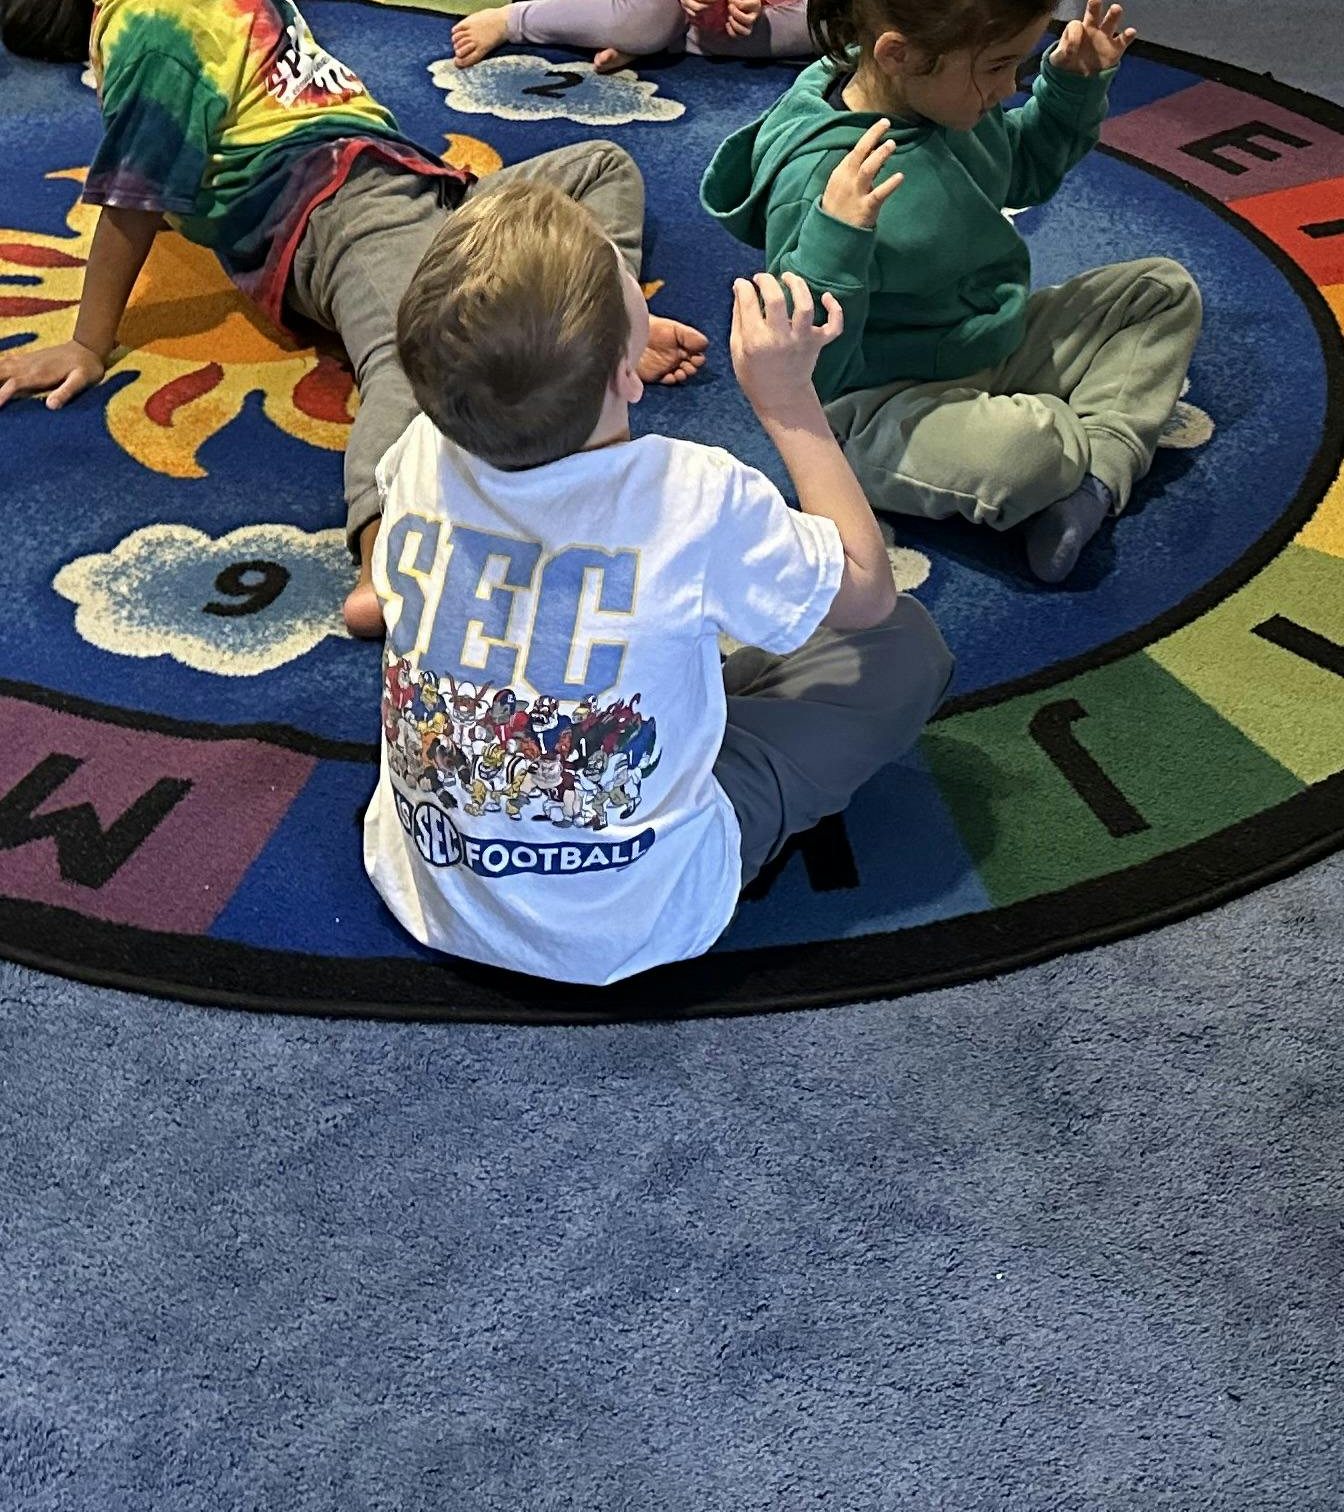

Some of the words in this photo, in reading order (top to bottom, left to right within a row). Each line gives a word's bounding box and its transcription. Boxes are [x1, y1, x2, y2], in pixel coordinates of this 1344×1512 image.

[522, 70, 585, 98] 2
[1177, 119, 1313, 176] E
[385, 512, 642, 701] SEC
[1028, 697, 1151, 839] J
[415, 802, 460, 865] SEC
[464, 839, 647, 873] FOOTBALL
